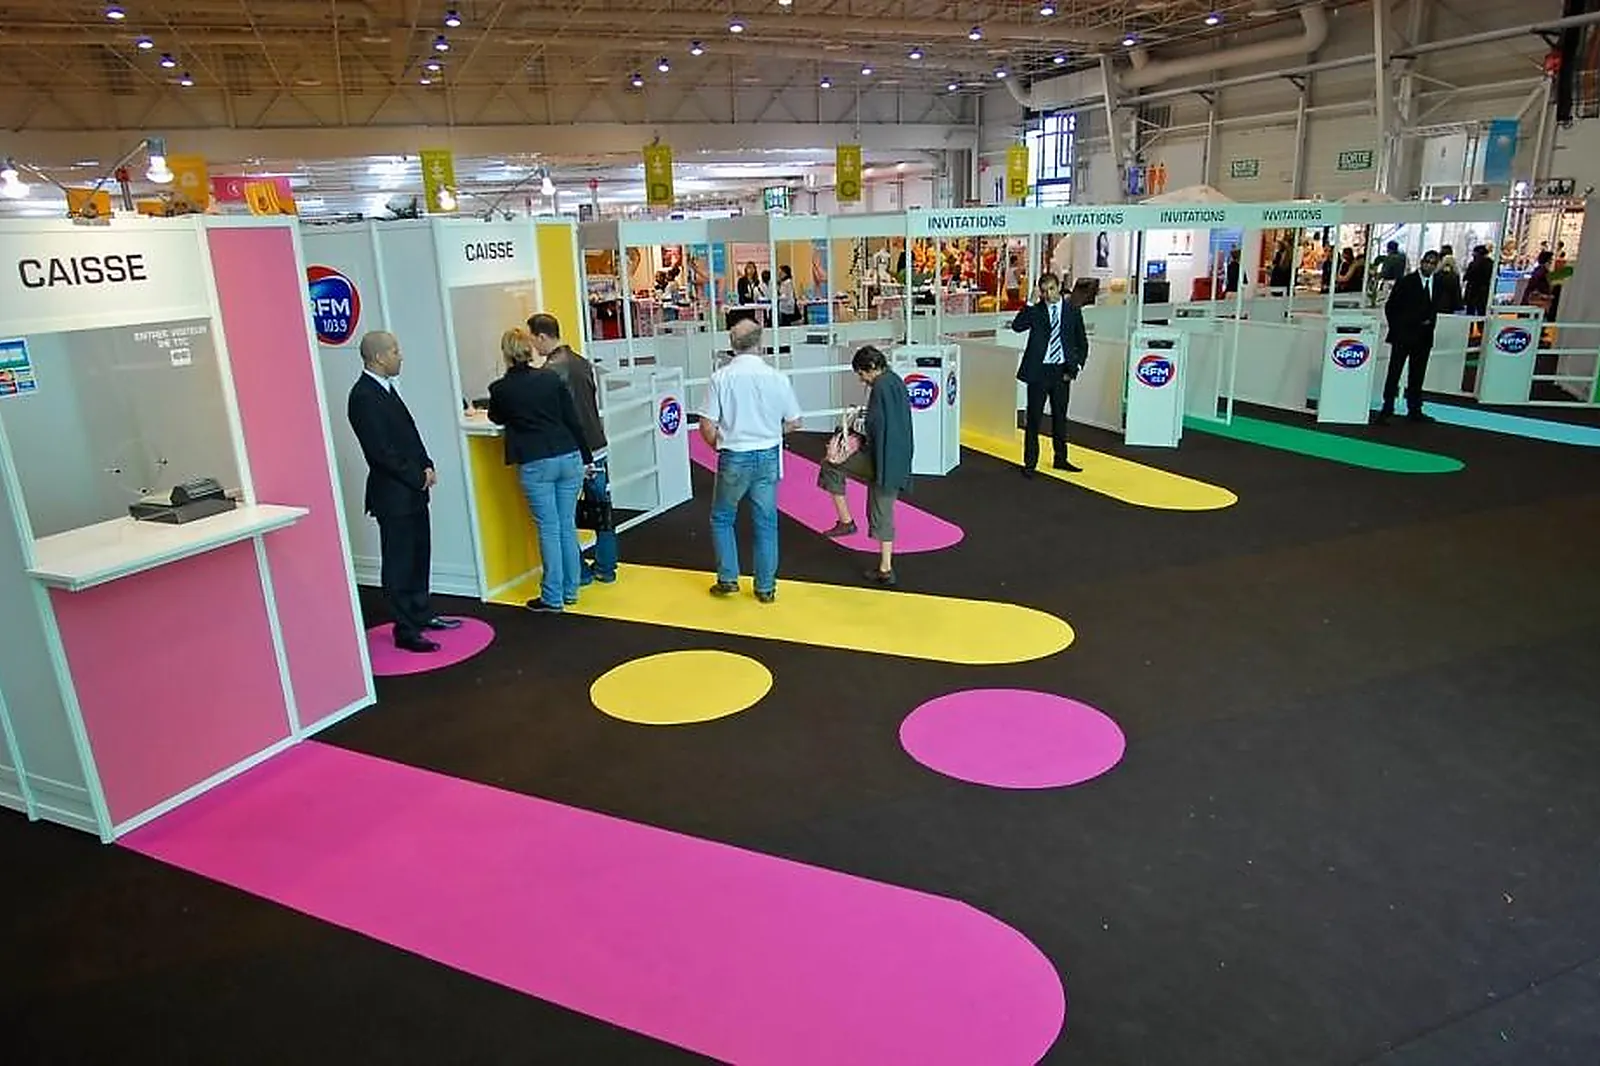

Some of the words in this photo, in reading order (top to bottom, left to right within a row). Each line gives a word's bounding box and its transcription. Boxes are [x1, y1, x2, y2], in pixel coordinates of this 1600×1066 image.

[651, 183, 669, 200] D
[841, 180, 857, 197] C
[1011, 178, 1025, 195] B
[928, 214, 1006, 229] INVITATIONS
[1052, 212, 1124, 225] INVITATIONS
[1160, 209, 1226, 223] INVITATIONS
[1263, 209, 1322, 221] INVITATIONS
[465, 240, 515, 262] CAISSE
[18, 254, 147, 288] CAISSE
